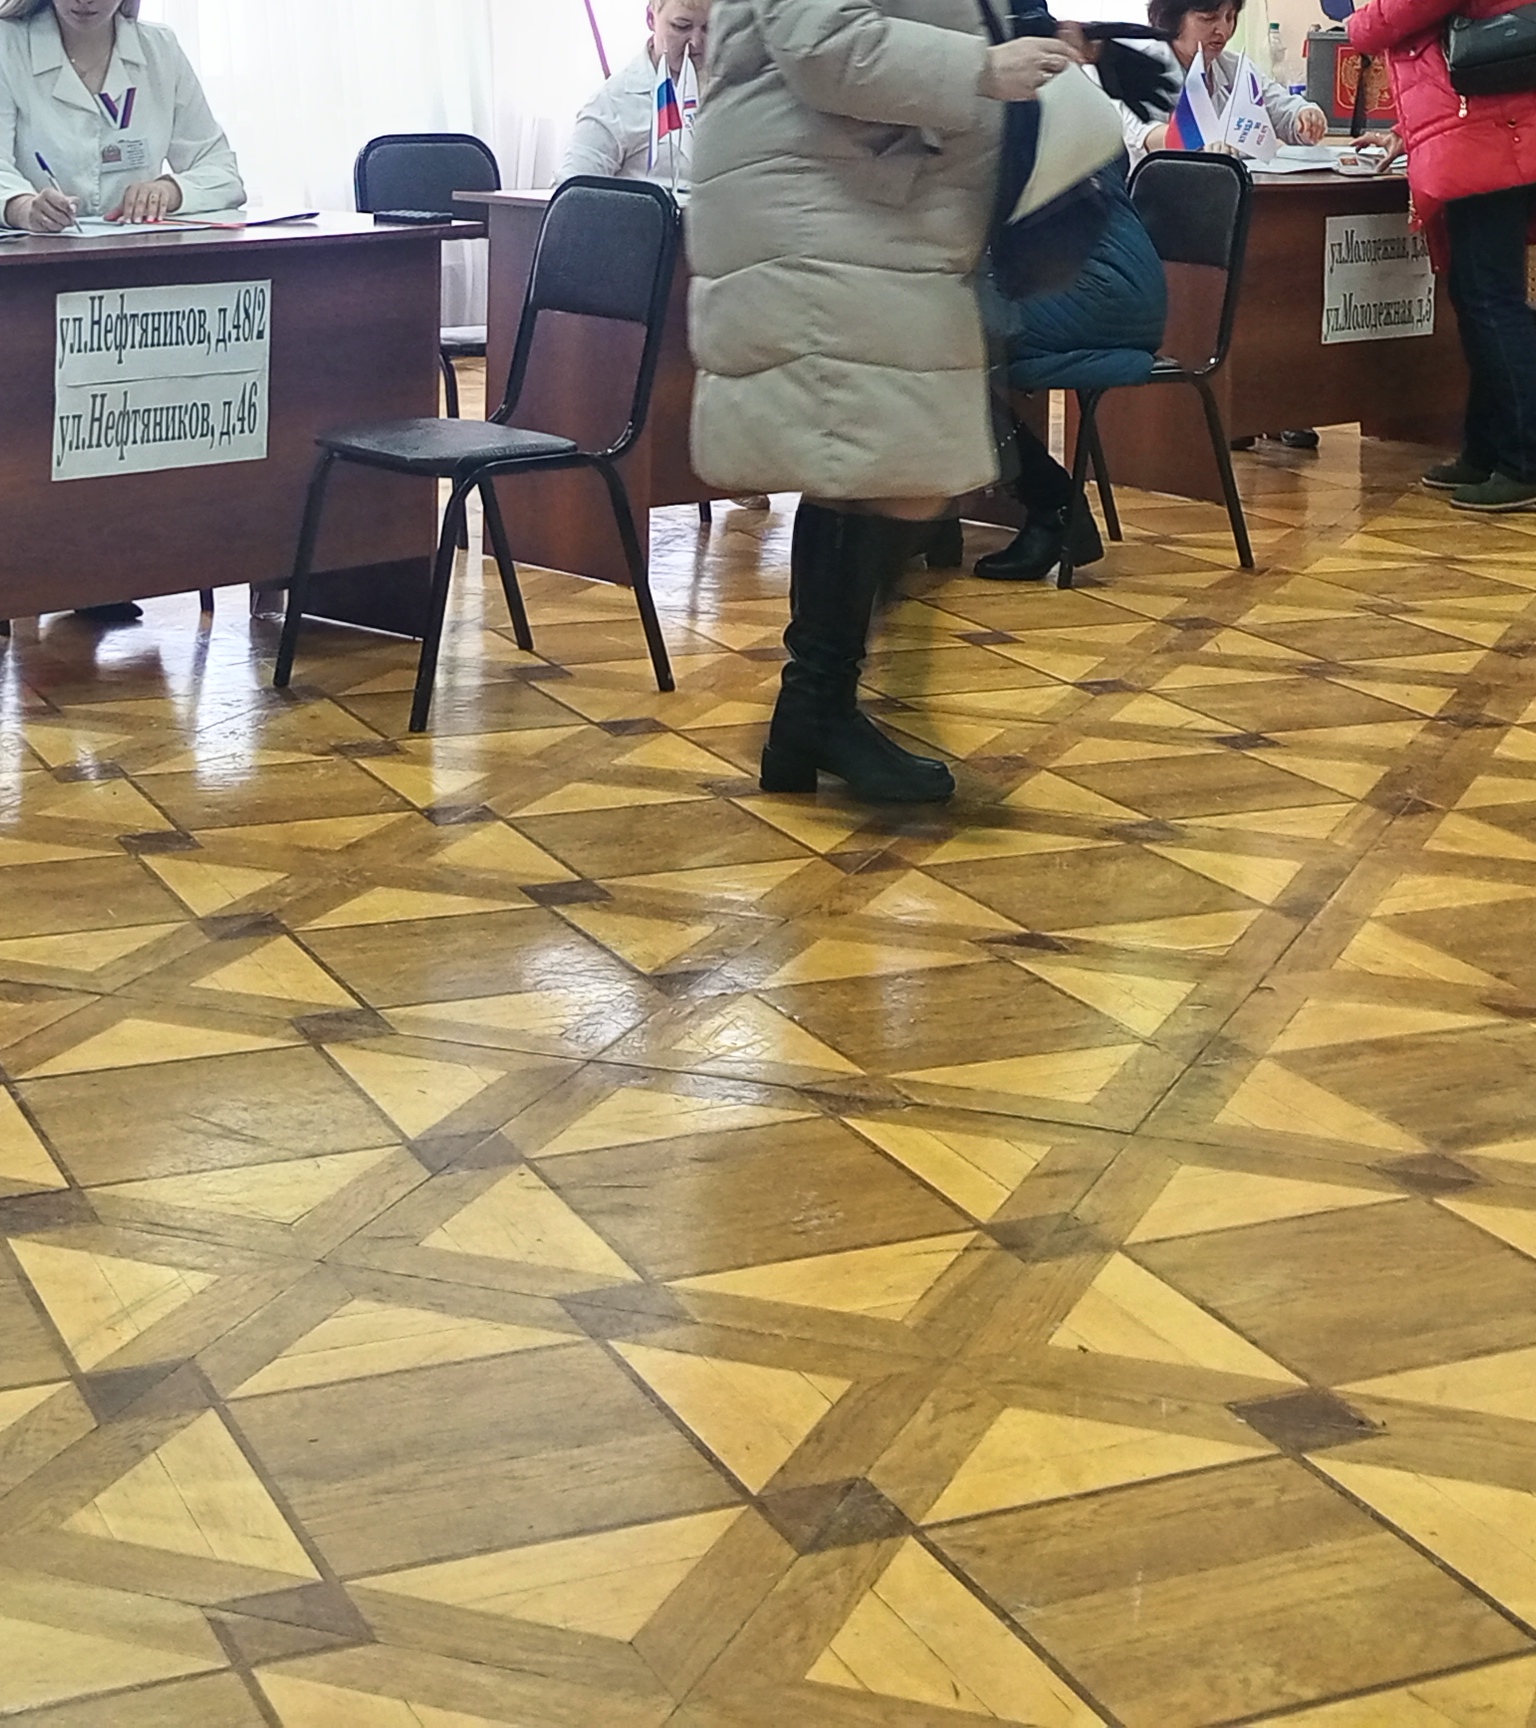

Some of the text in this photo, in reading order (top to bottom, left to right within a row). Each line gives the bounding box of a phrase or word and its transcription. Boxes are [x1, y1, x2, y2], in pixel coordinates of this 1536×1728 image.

[59, 288, 266, 369] ул.Нефтяников, д.48/2
[56, 381, 258, 468] ул.Нефтяников, д.46
